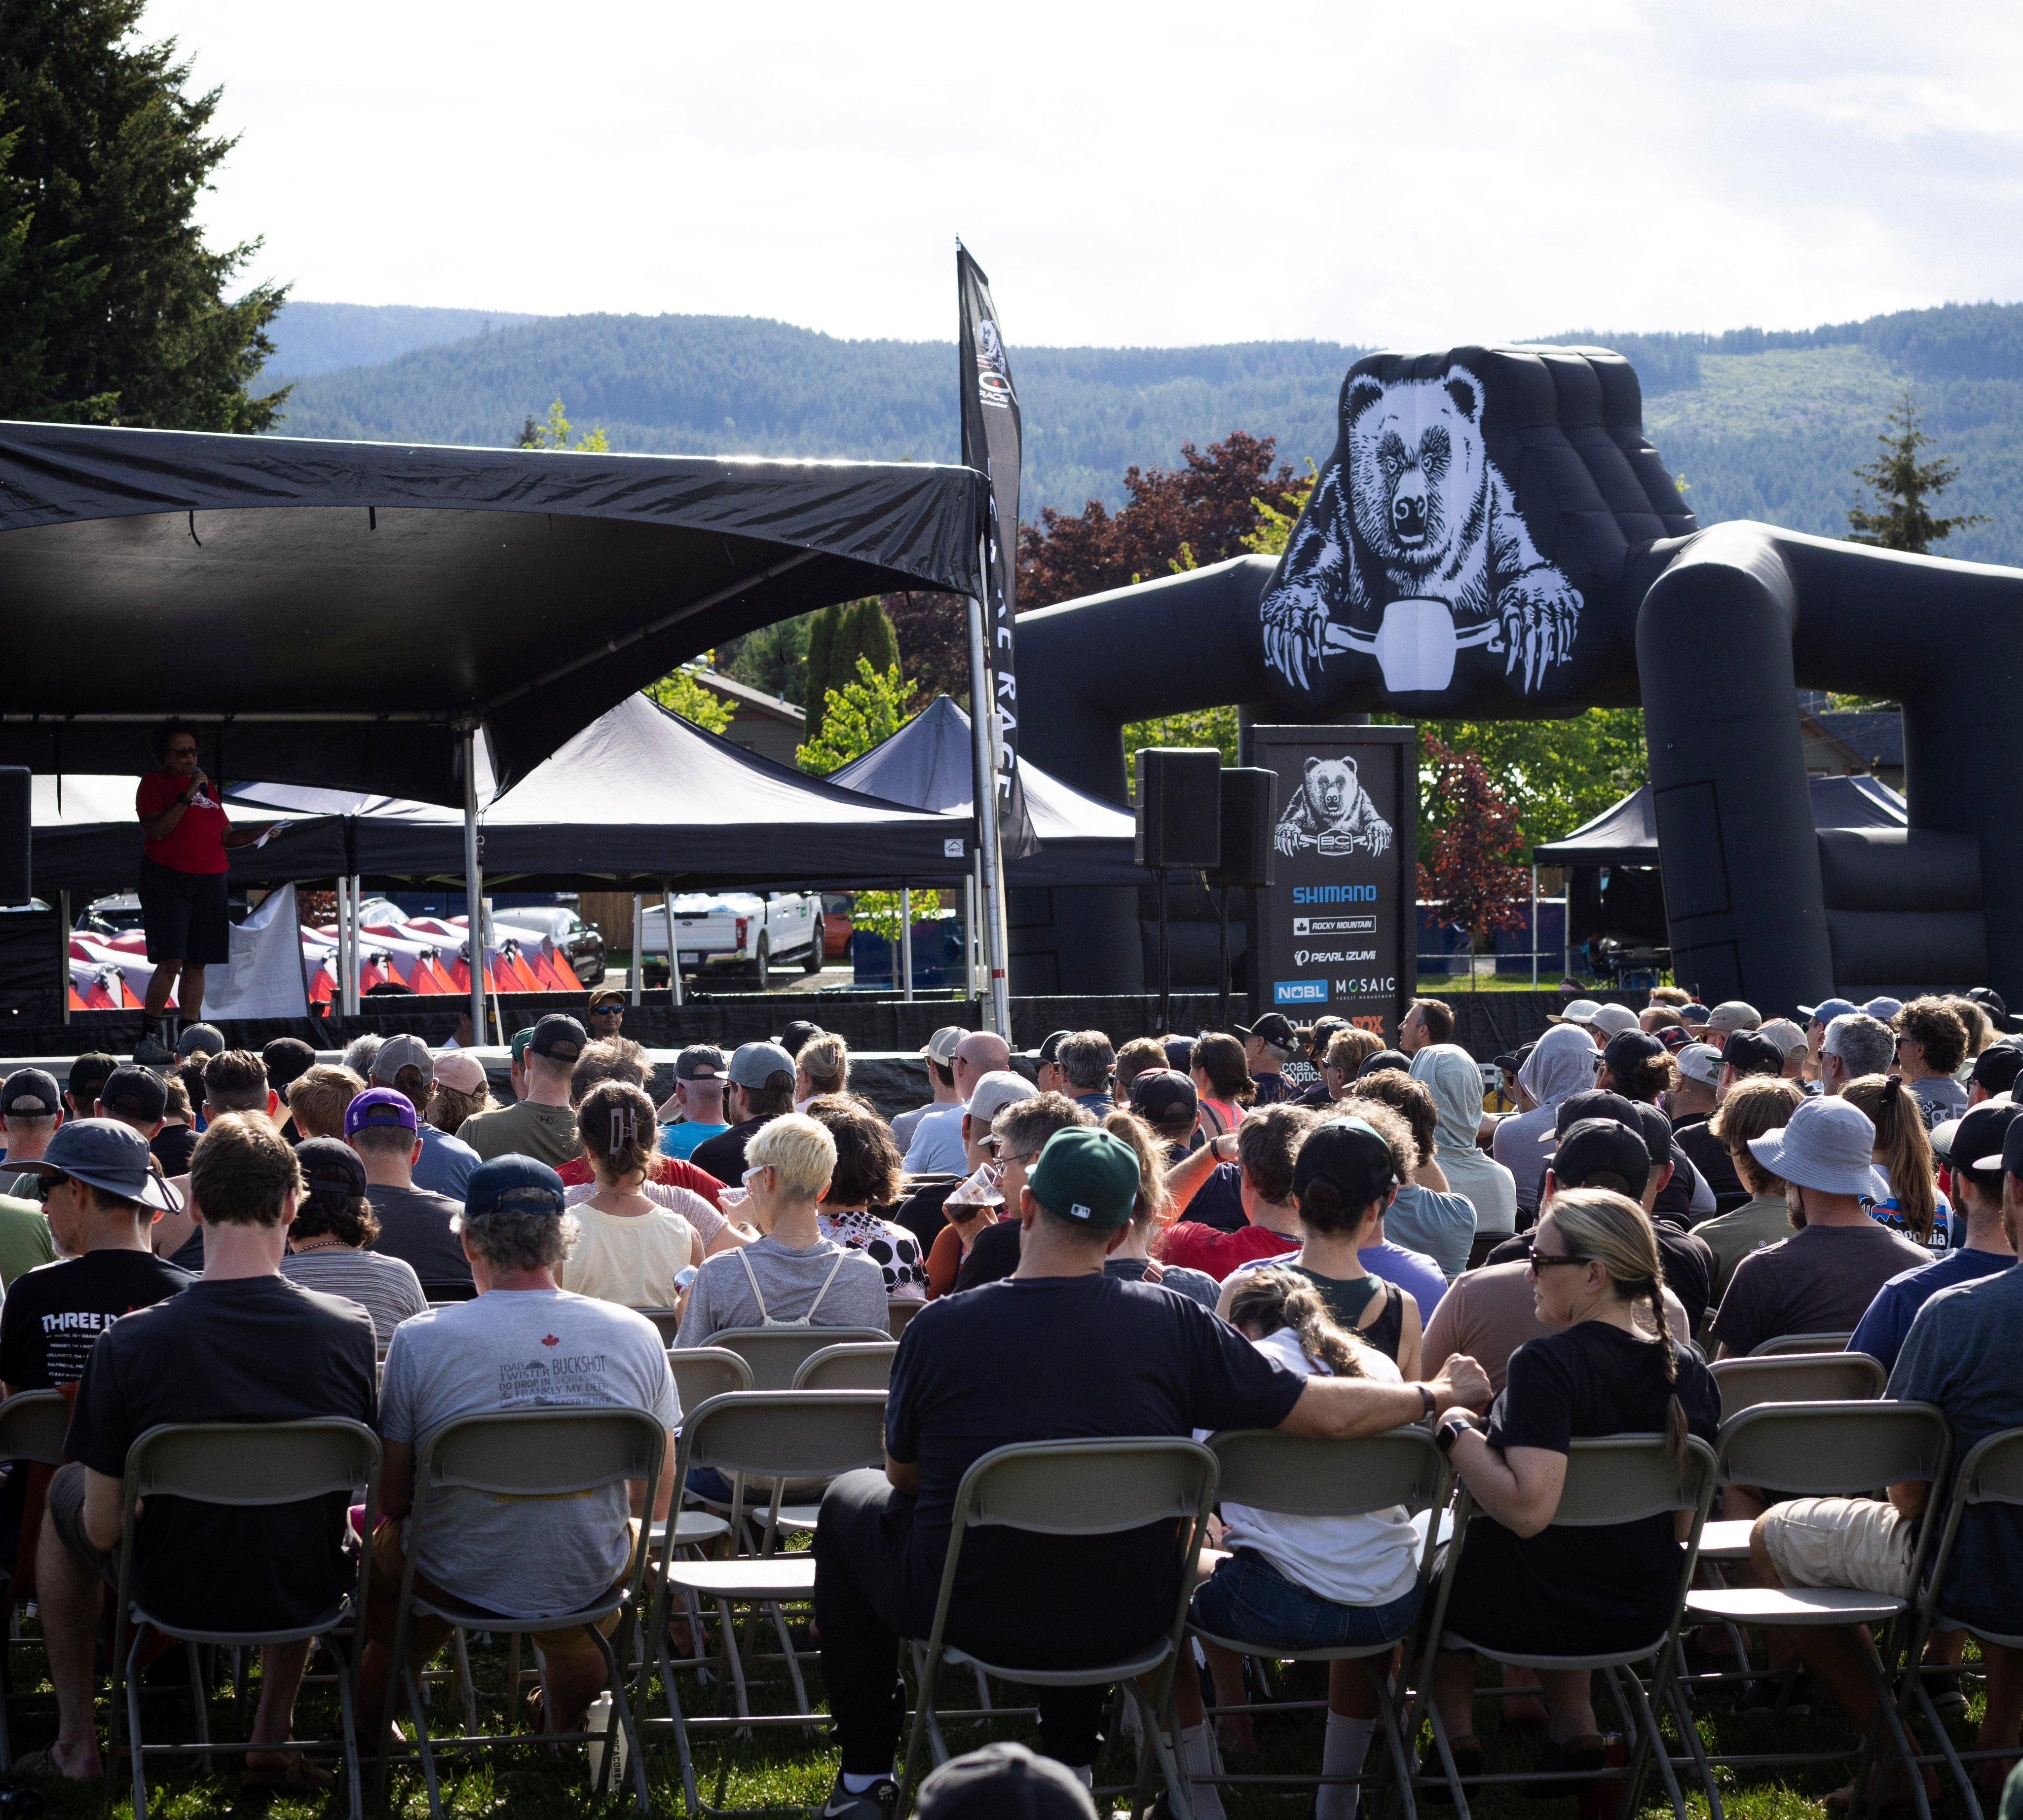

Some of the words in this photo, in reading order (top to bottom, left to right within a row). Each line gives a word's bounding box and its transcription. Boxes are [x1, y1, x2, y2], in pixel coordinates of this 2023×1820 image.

[1321, 835, 1350, 845] BC
[1293, 885, 1377, 903] SHIMANO
[1312, 922, 1335, 930] ROCKY
[1336, 920, 1372, 929] MOUNTAIN
[1311, 952, 1345, 962] PEARL
[1278, 985, 1325, 999] NOBL
[1336, 977, 1395, 993] MOSAIC
[1352, 1015, 1385, 1034] FOX
[41, 1312, 100, 1333] THREE
[499, 1363, 524, 1373] TOAD
[552, 1356, 606, 1375] BUCKSHOT
[500, 1369, 550, 1381] TWISTER
[499, 1382, 512, 1391] DO
[515, 1379, 539, 1389] DROP
[541, 1377, 551, 1386] IN
[516, 1386, 562, 1398] FRANKLY
[566, 1384, 582, 1393] MY
